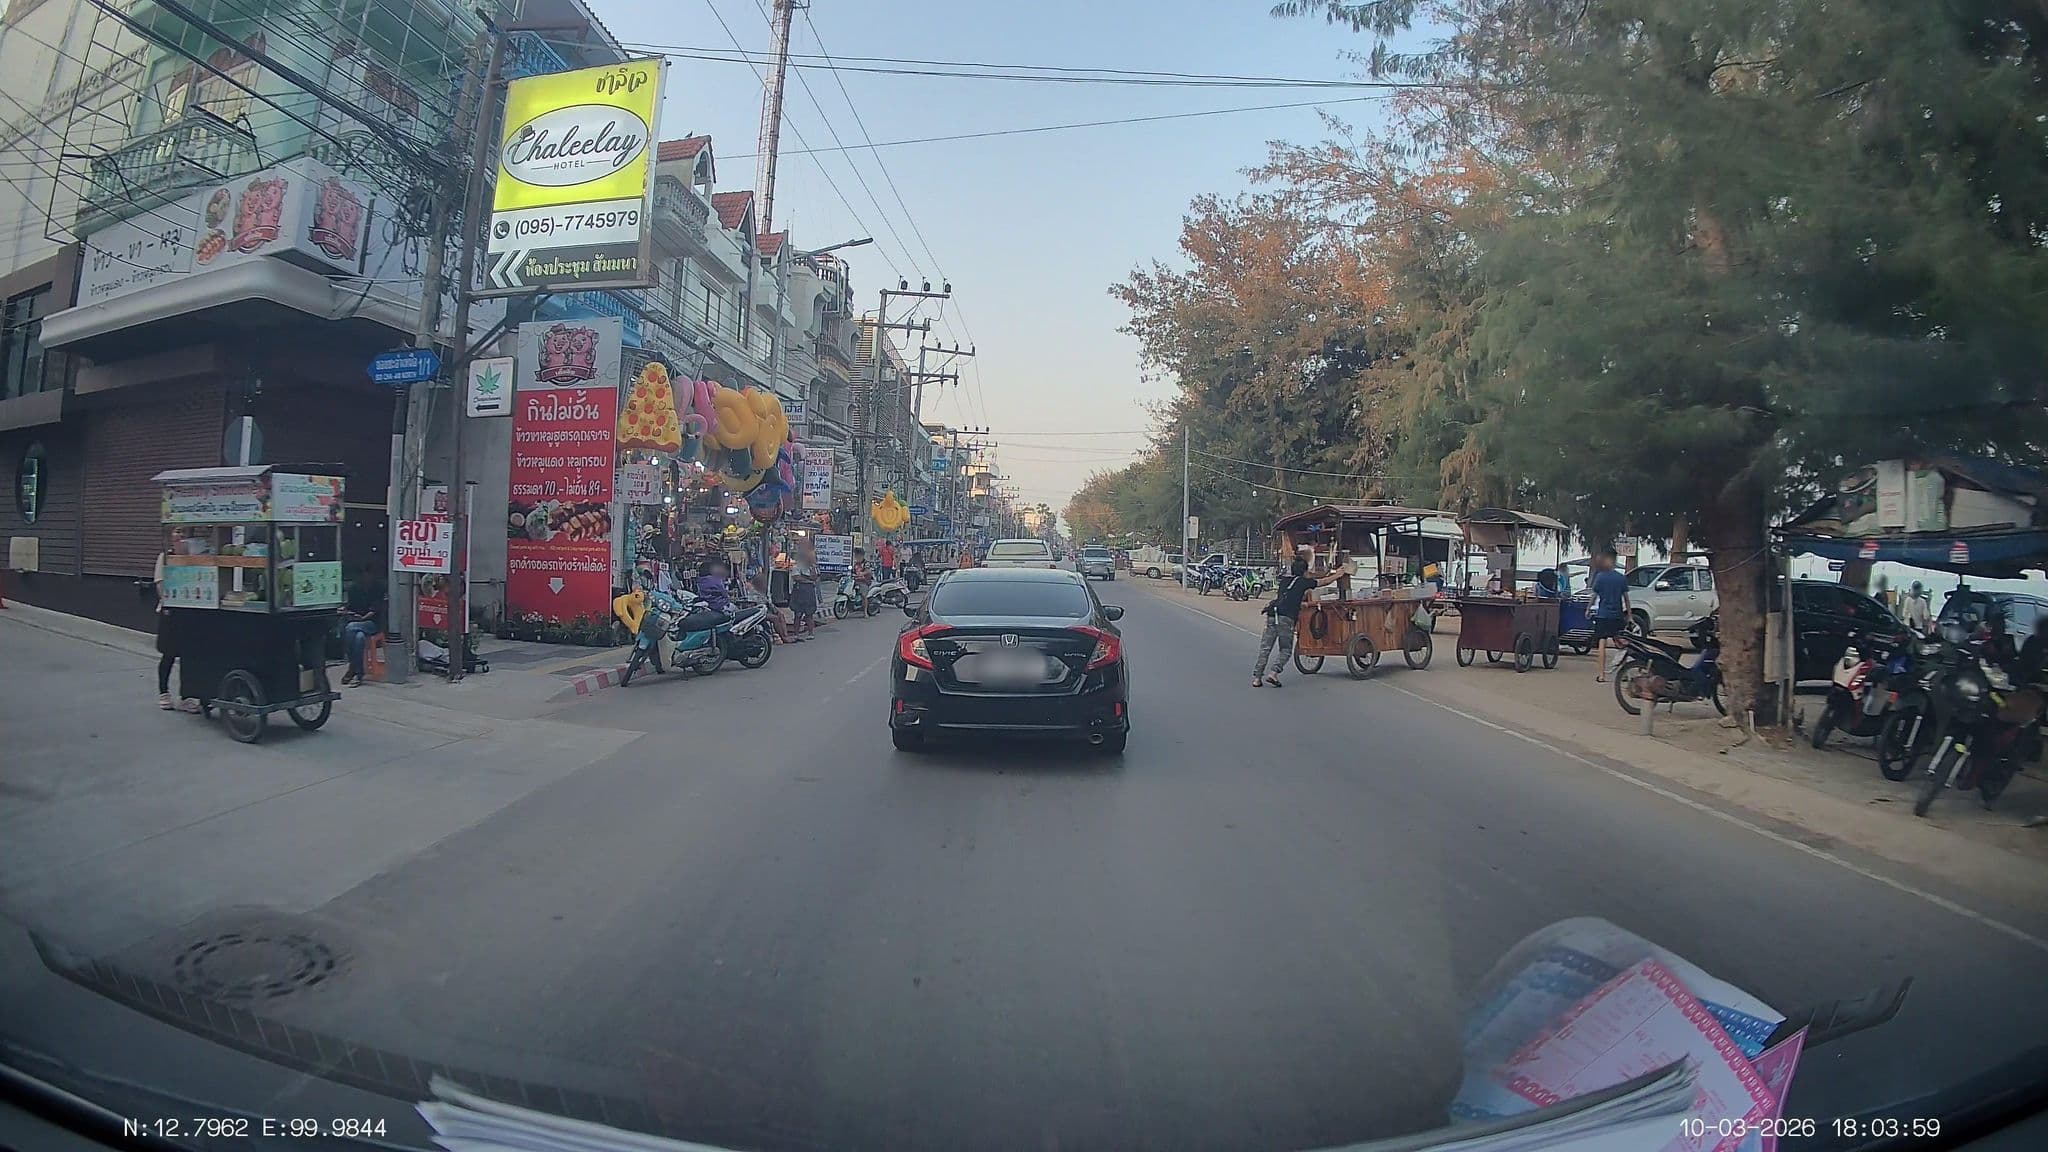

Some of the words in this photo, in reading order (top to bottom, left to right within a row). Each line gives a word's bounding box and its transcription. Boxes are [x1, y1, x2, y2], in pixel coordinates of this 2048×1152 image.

[507, 120, 642, 168] Chaleelay
[553, 160, 585, 171] HOTEL
[515, 210, 639, 239] (095)-7745979
[525, 256, 590, 279] ห้องประชุม
[593, 253, 637, 273] สัมมนา
[418, 356, 431, 376] 1/1
[527, 389, 600, 422] กินไม่อั้น
[516, 427, 610, 447] ข้าวขาหมูสูตรคุณยาย
[516, 453, 564, 473] ข้าวหมูแดง
[567, 456, 607, 474] หมูกรอบ
[513, 483, 543, 496] ธรรมดา
[564, 474, 587, 496] ไม่อั้น
[399, 521, 437, 546] สุขา
[442, 531, 449, 540] 5
[437, 550, 449, 558] 10
